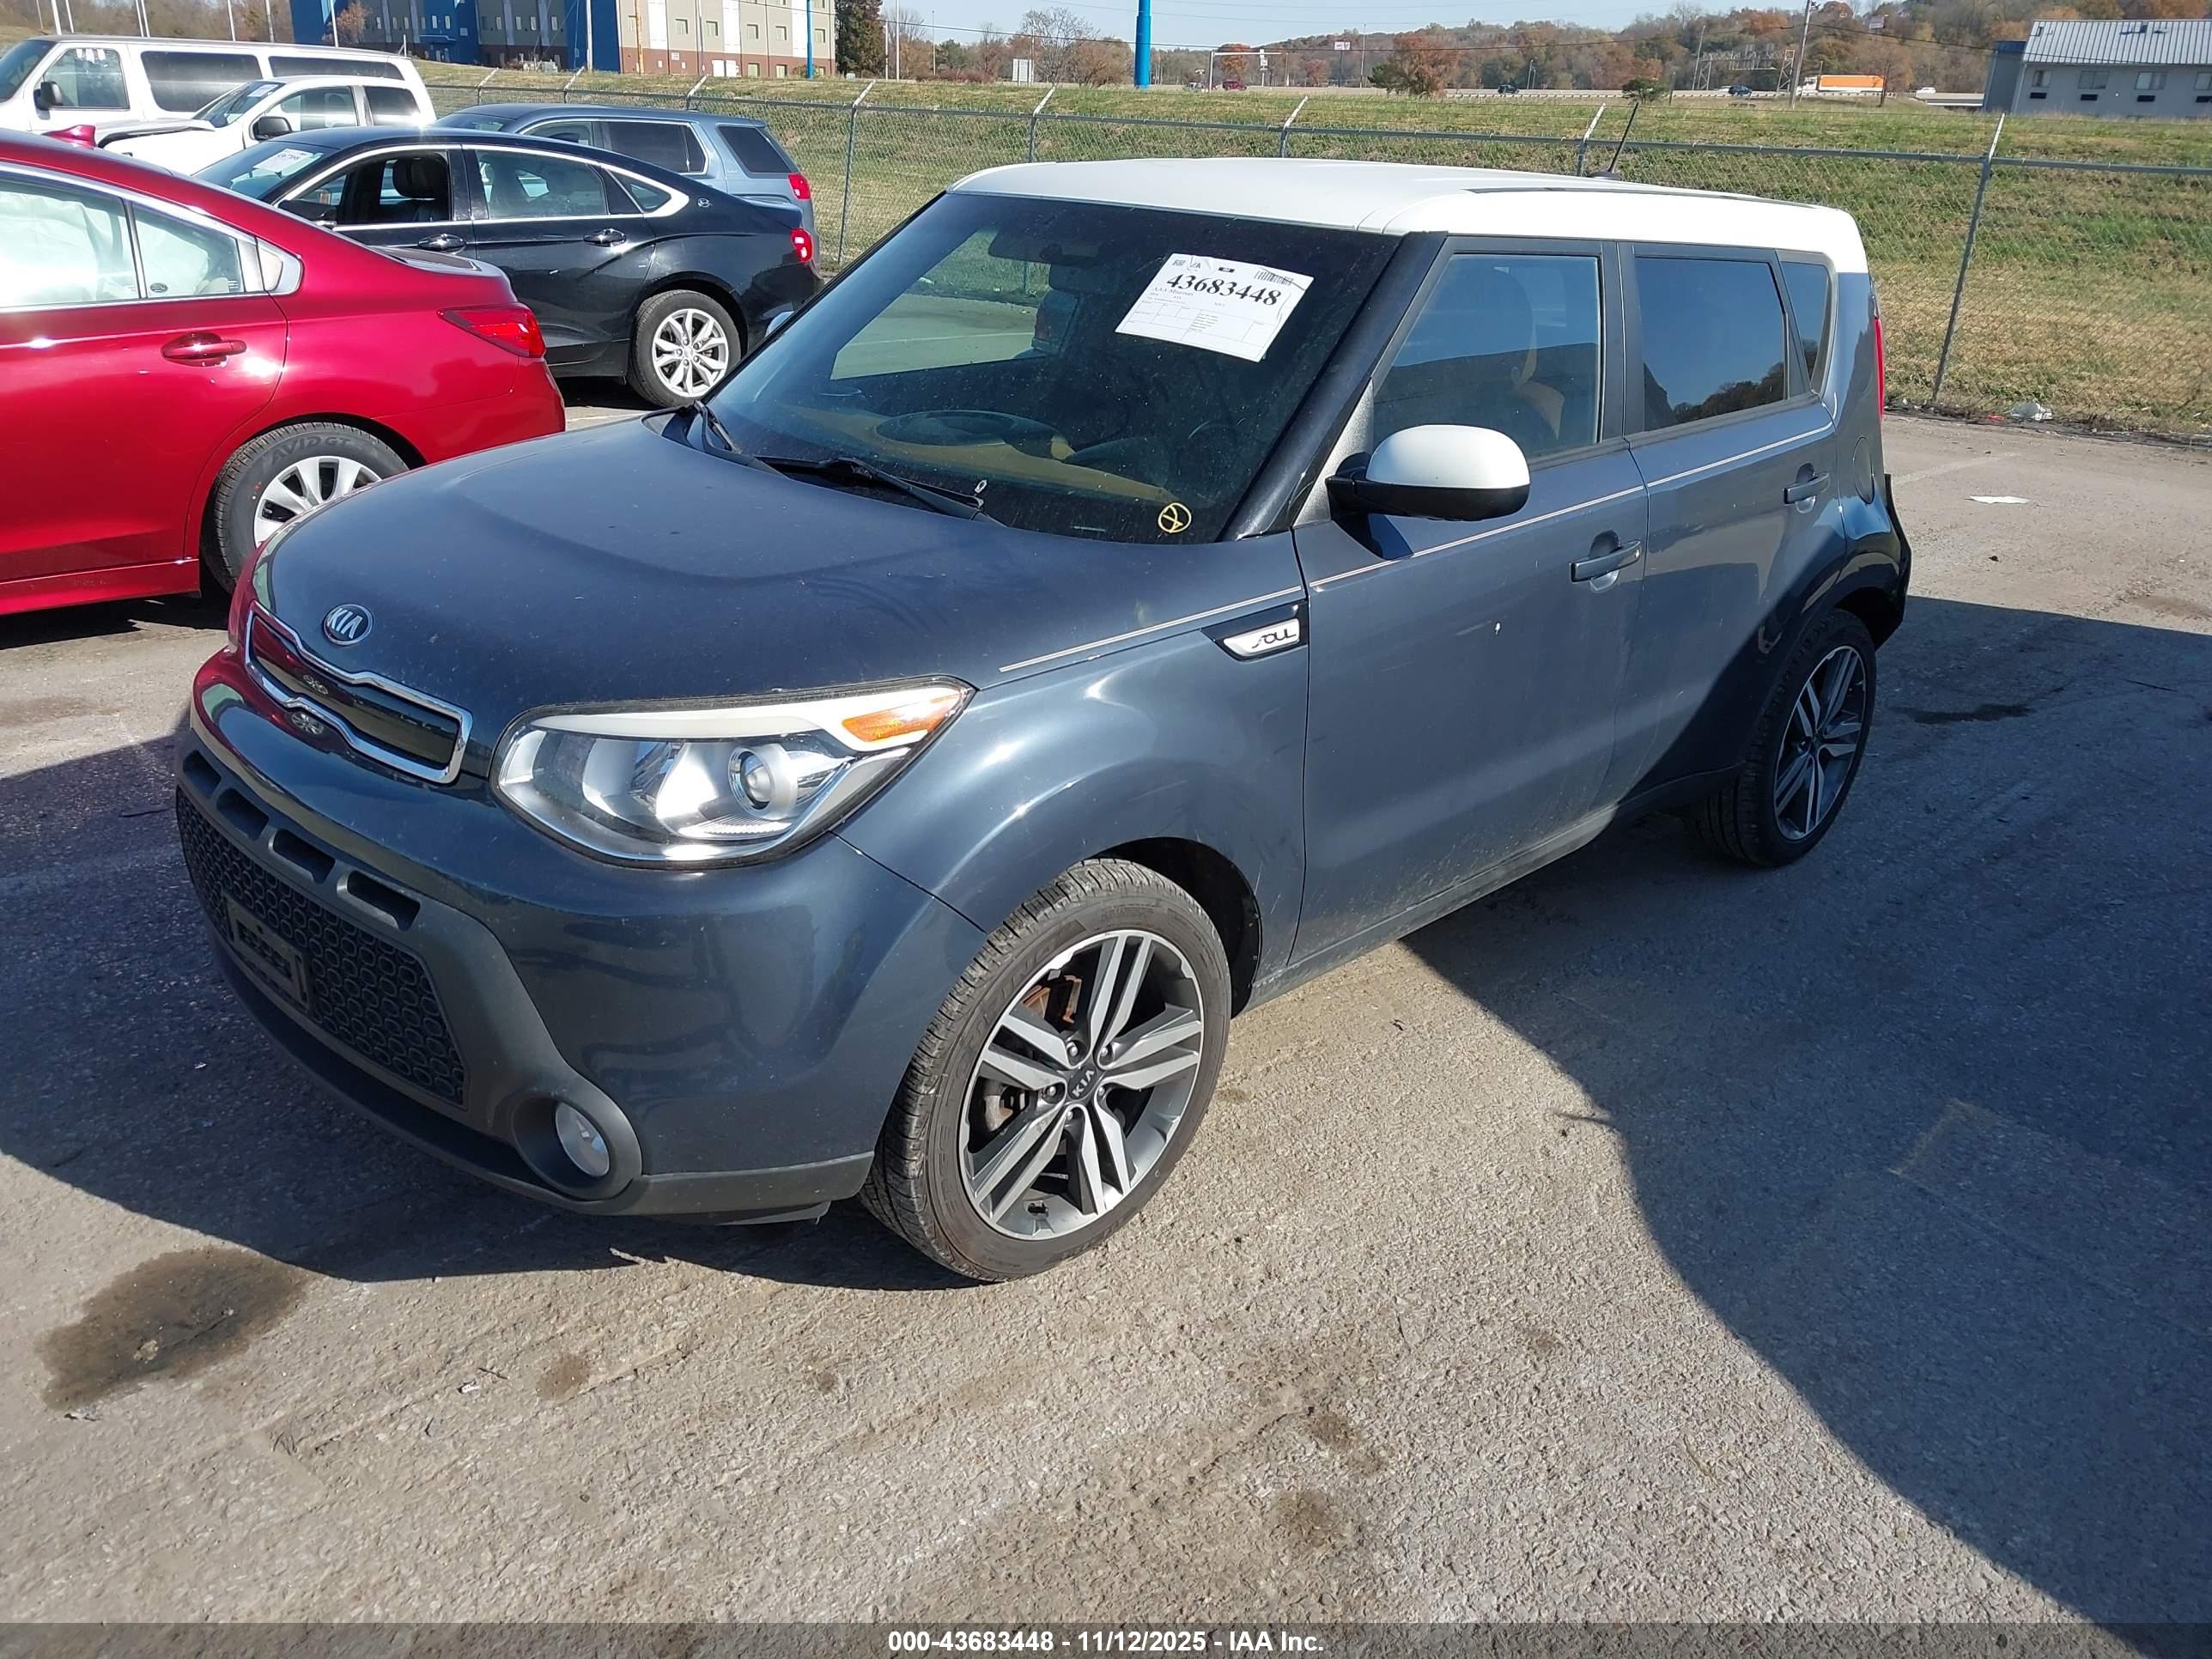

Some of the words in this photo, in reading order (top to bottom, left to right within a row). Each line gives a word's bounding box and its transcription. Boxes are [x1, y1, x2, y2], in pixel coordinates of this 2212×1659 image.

[1167, 273, 1282, 307] 43683448
[326, 606, 364, 640] KIA
[1251, 628, 1297, 649] SOUL
[1071, 1069, 1095, 1097] KIA
